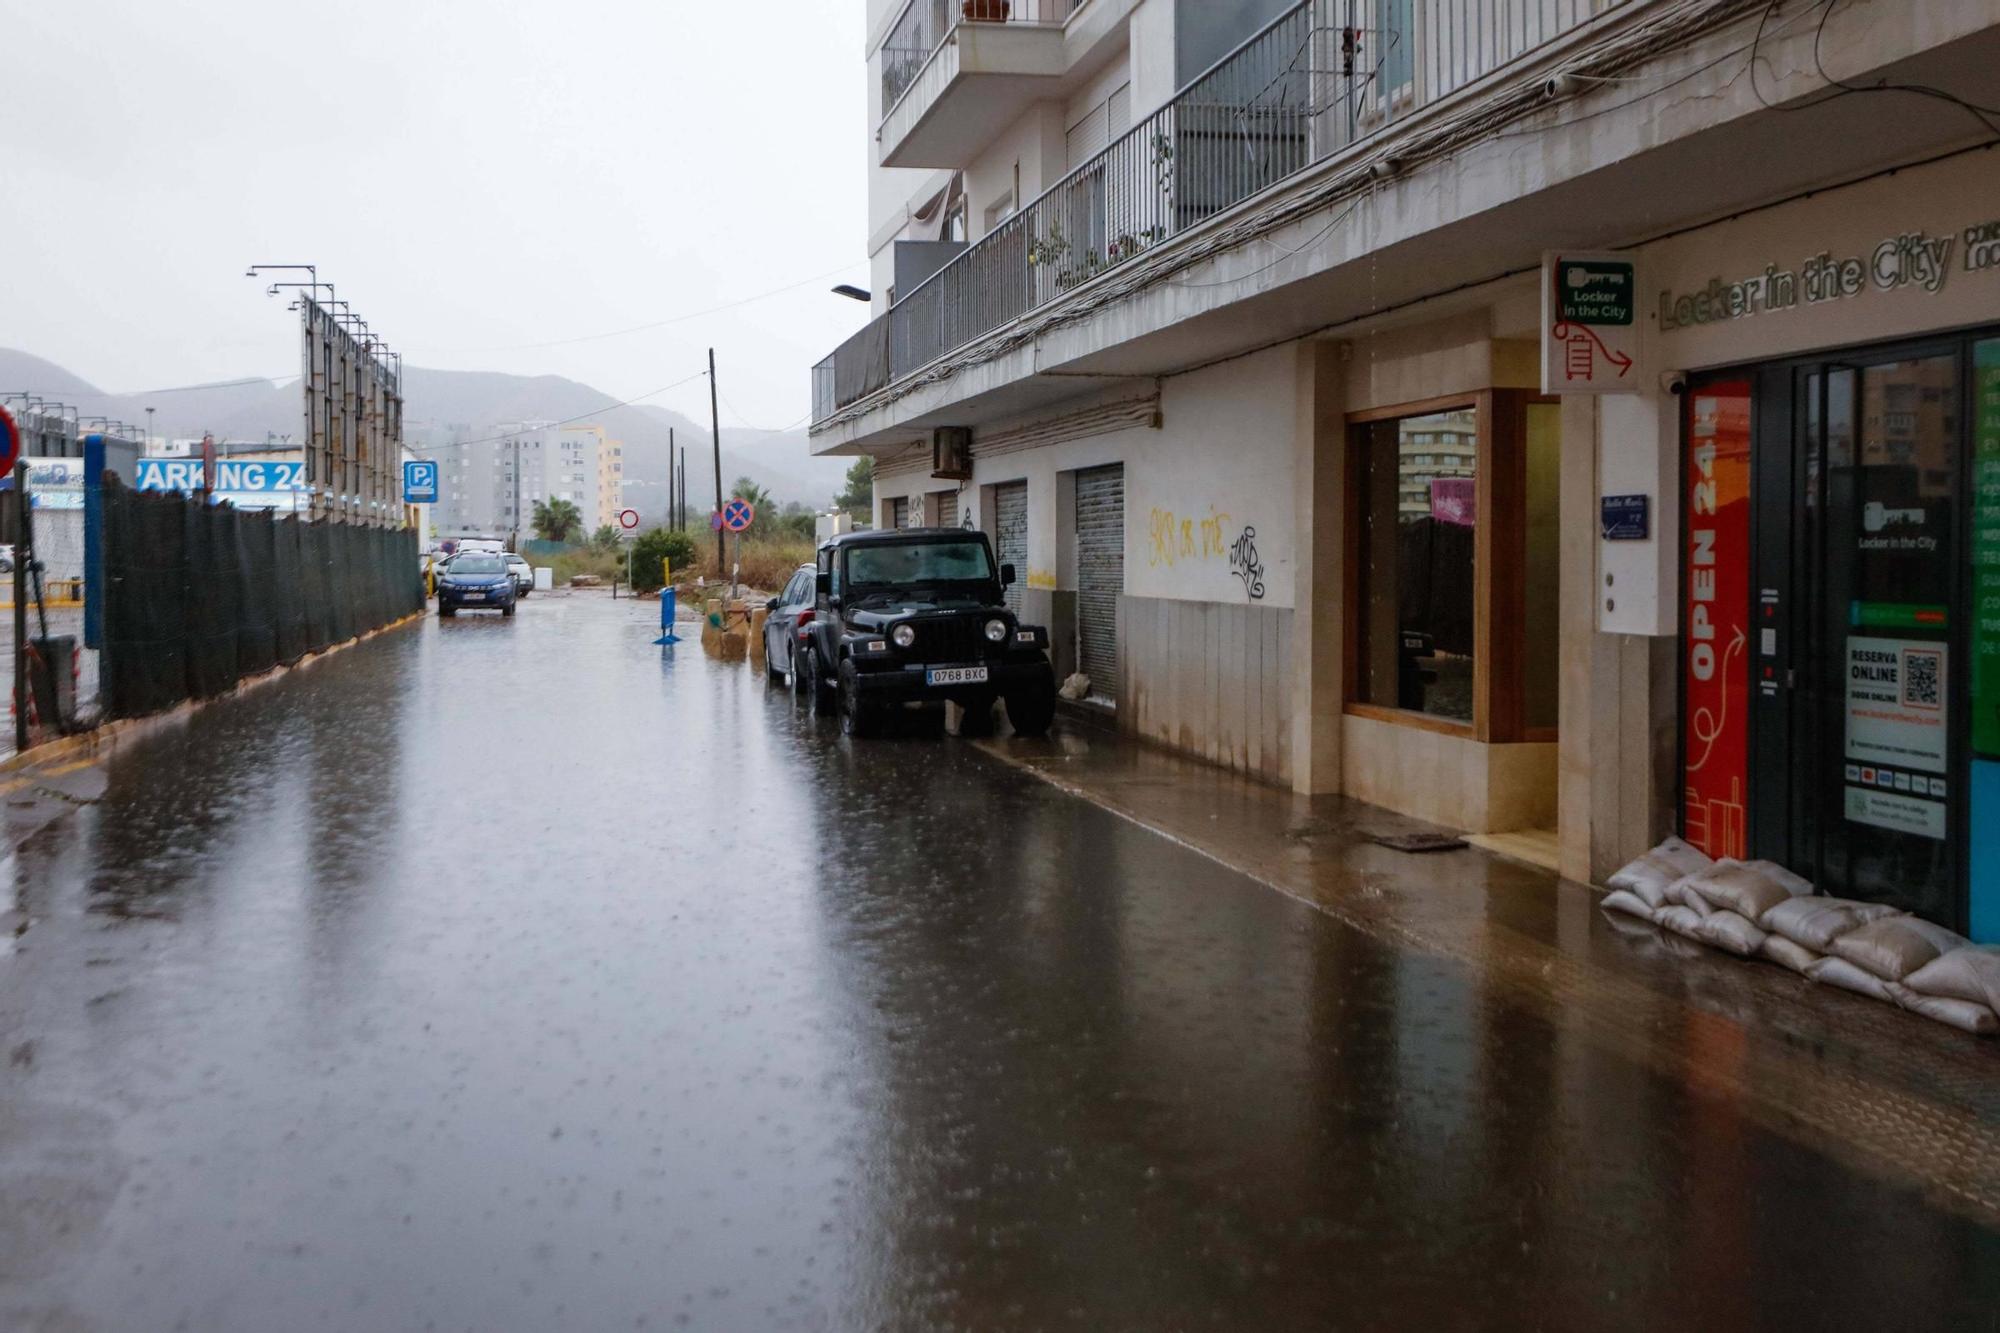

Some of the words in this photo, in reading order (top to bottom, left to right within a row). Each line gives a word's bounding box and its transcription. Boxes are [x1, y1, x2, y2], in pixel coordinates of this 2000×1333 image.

[1658, 276, 1764, 335] Locker
[1765, 263, 1797, 313] in
[1803, 251, 1866, 302] the
[1871, 231, 1955, 294] City
[1574, 290, 1617, 302] Locker
[1578, 305, 1599, 316] the
[1601, 305, 1627, 319] City
[1693, 396, 1717, 516] 24H
[414, 466, 428, 484] P
[1858, 536, 1888, 549] Locker
[1890, 537, 1899, 549] in
[1900, 536, 1917, 549] the
[1918, 536, 1937, 552] City
[1692, 529, 1716, 681] OPEN
[1851, 650, 1898, 664] RESERVA
[934, 671, 962, 682] 0768
[964, 668, 985, 680] BXC
[1851, 665, 1898, 683] ONLINE
[1851, 690, 1870, 701] BOOK
[1871, 692, 1897, 704] ONLINE
